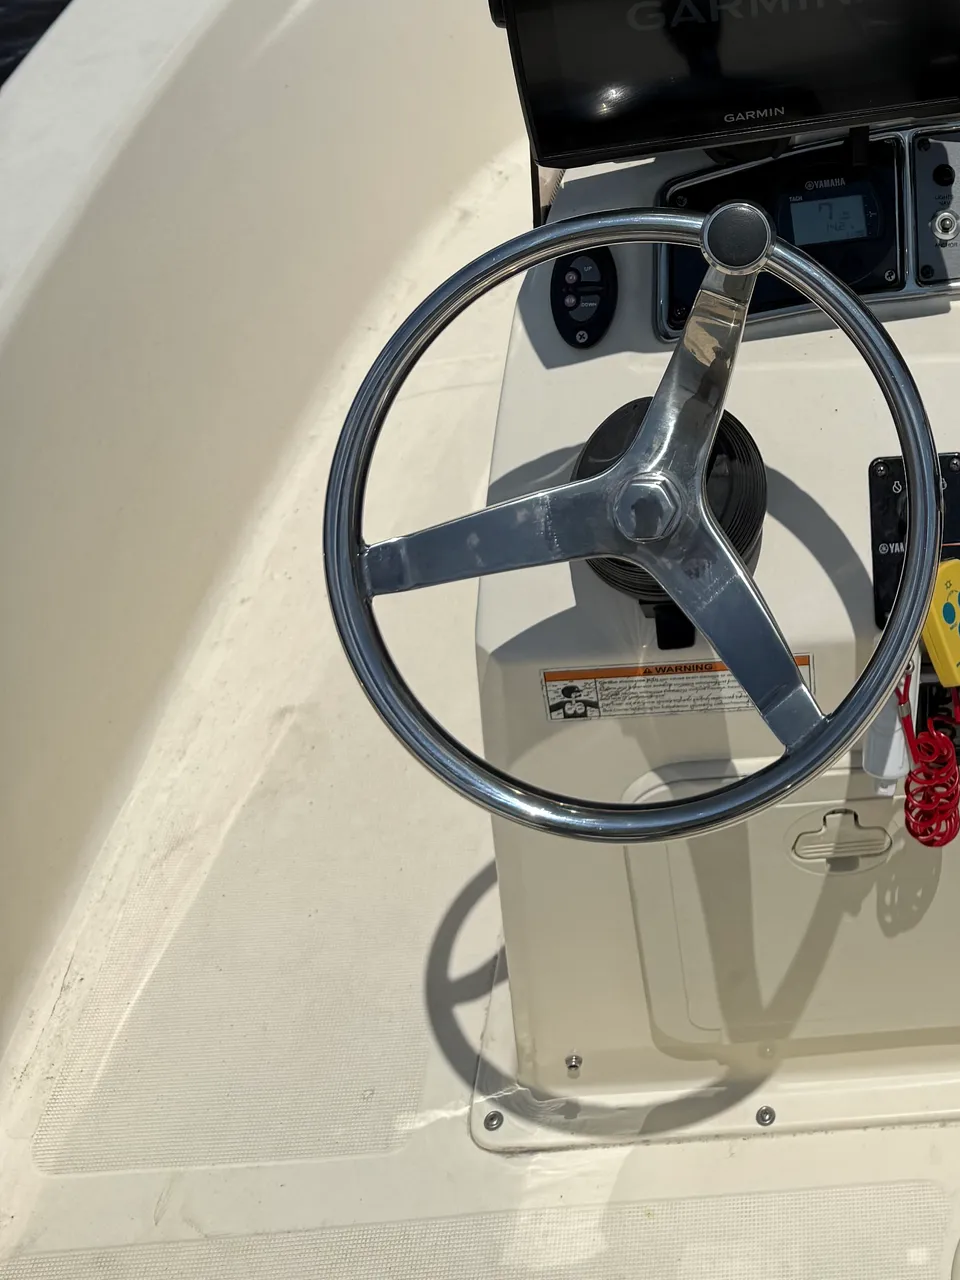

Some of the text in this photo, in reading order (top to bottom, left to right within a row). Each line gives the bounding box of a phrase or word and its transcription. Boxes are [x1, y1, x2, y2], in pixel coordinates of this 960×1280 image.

[724, 106, 785, 123] GARMIN
[813, 177, 846, 189] YAMAHA
[818, 202, 833, 220] 7
[655, 663, 713, 674] WARNING
